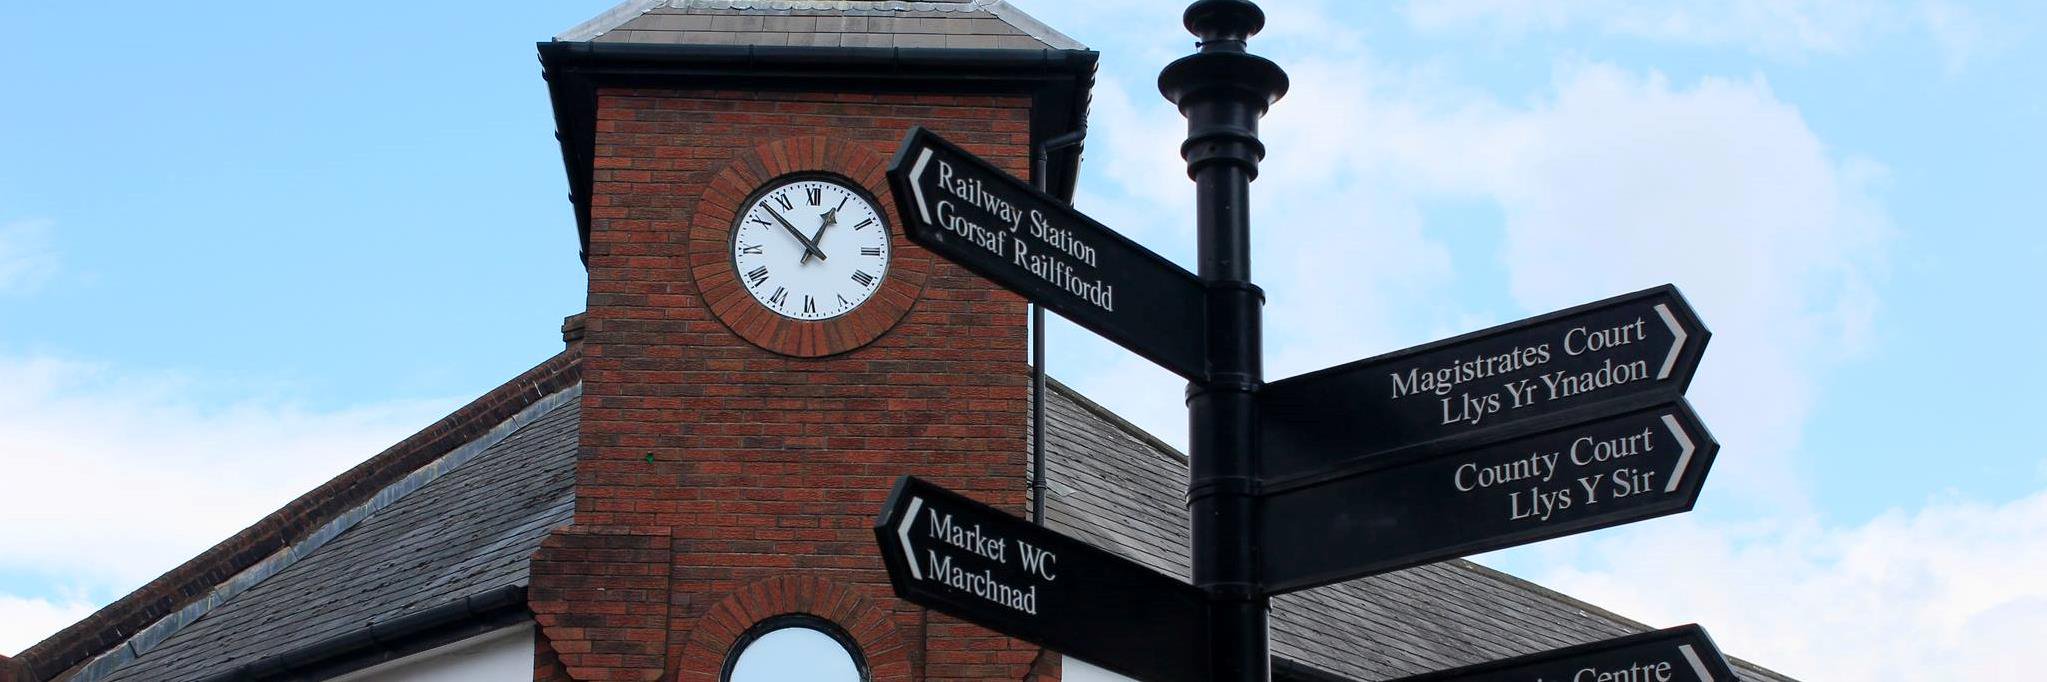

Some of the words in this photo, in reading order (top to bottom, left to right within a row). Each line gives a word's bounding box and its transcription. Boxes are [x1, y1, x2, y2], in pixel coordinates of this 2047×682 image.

[752, 214, 772, 230] X
[775, 193, 794, 213] XI
[806, 188, 821, 206] XII
[937, 160, 1022, 233] Railway
[1029, 209, 1096, 268] Station
[936, 200, 1006, 257] Gorsaf
[1013, 237, 1114, 312] Railffordd
[837, 294, 848, 307] V
[1390, 342, 1551, 399] Magistrates
[1563, 317, 1647, 357] Court
[1441, 393, 1501, 425] Llys
[1504, 379, 1538, 409] Yr
[1540, 358, 1649, 400] Ynadon
[1454, 451, 1560, 492] County
[1570, 426, 1654, 467] Court
[1509, 487, 1572, 521] Llys
[1577, 474, 1604, 505] Y
[1612, 468, 1655, 499] Sir
[928, 507, 1006, 564] Market
[1017, 539, 1057, 581] WC
[928, 550, 1037, 615] Marchnad
